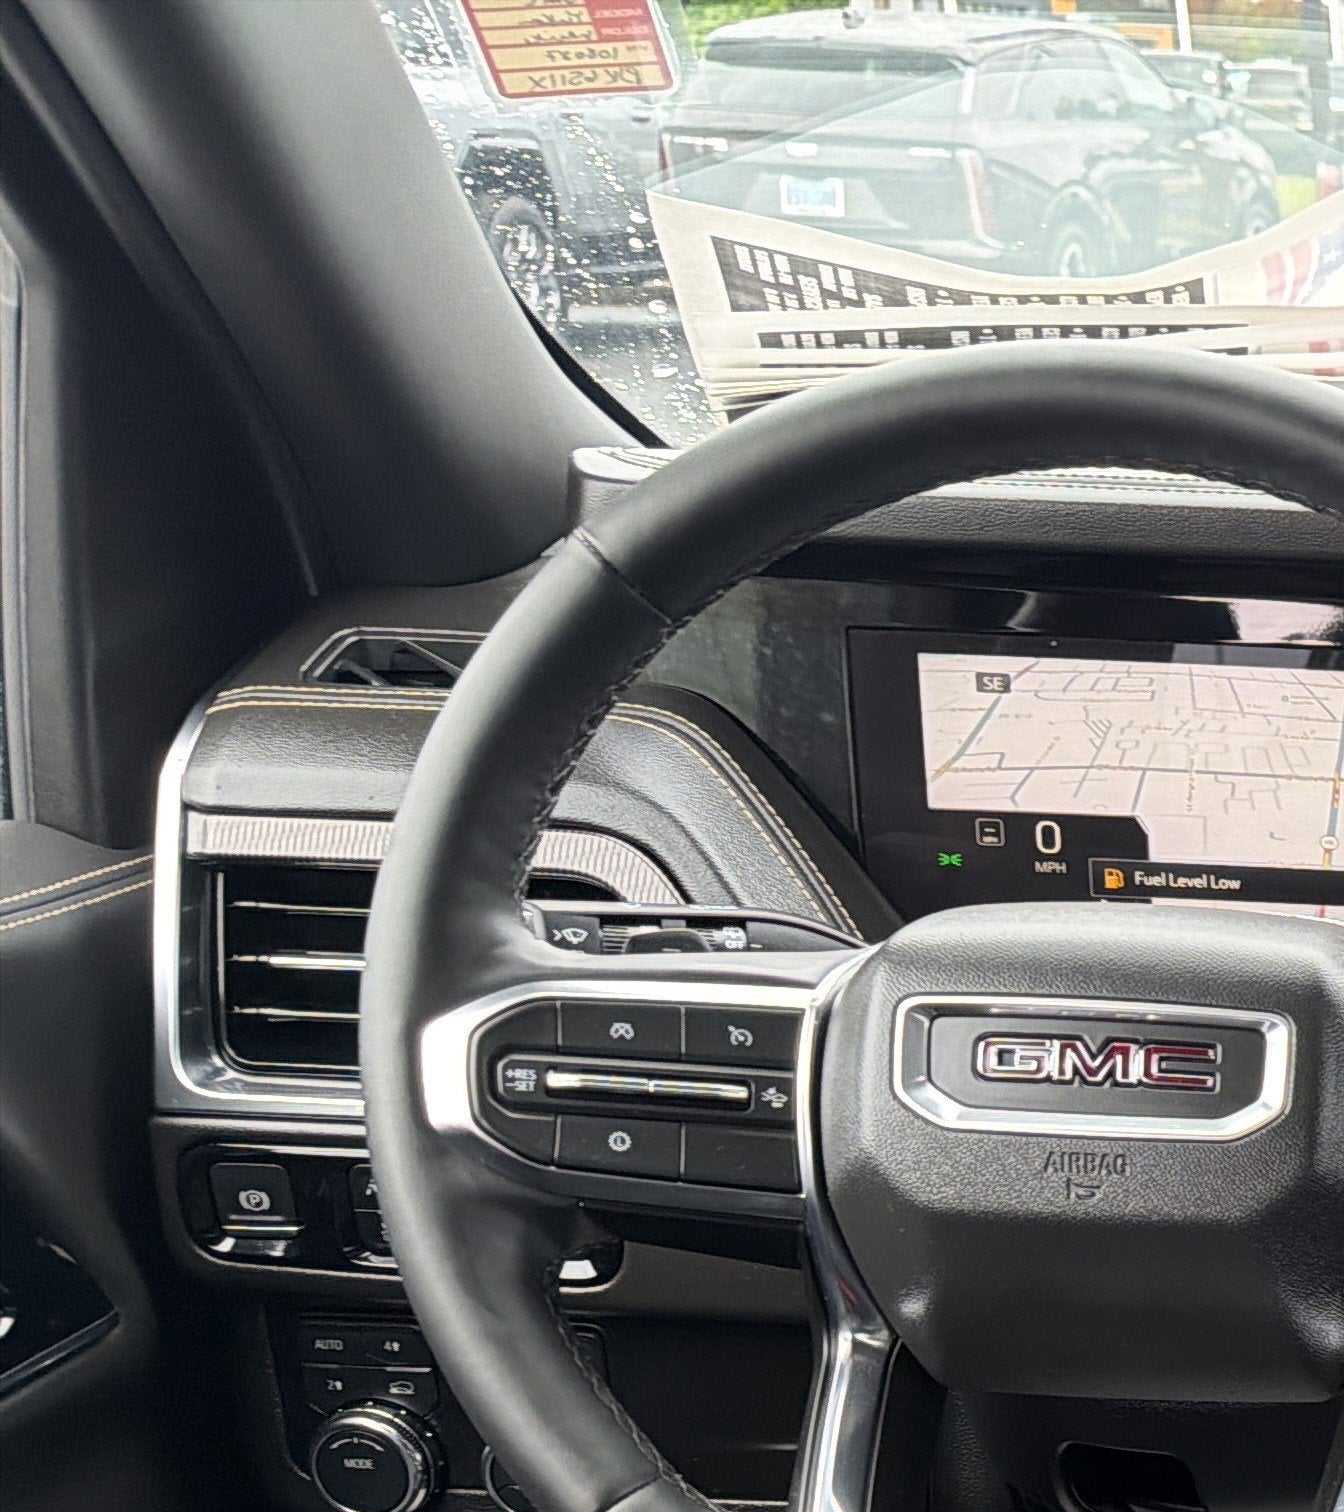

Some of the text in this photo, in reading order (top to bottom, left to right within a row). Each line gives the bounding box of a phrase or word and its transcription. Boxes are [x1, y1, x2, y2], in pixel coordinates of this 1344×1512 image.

[982, 675, 1005, 691] SE
[1035, 820, 1062, 854] 0
[1034, 861, 1067, 874] MPH
[1135, 871, 1241, 891] Fuel Level Low
[976, 1033, 1221, 1093] GMC
[1044, 1152, 1129, 1176] AIRBAG
[314, 1338, 344, 1351] AUTO
[343, 1457, 375, 1470] MODE
